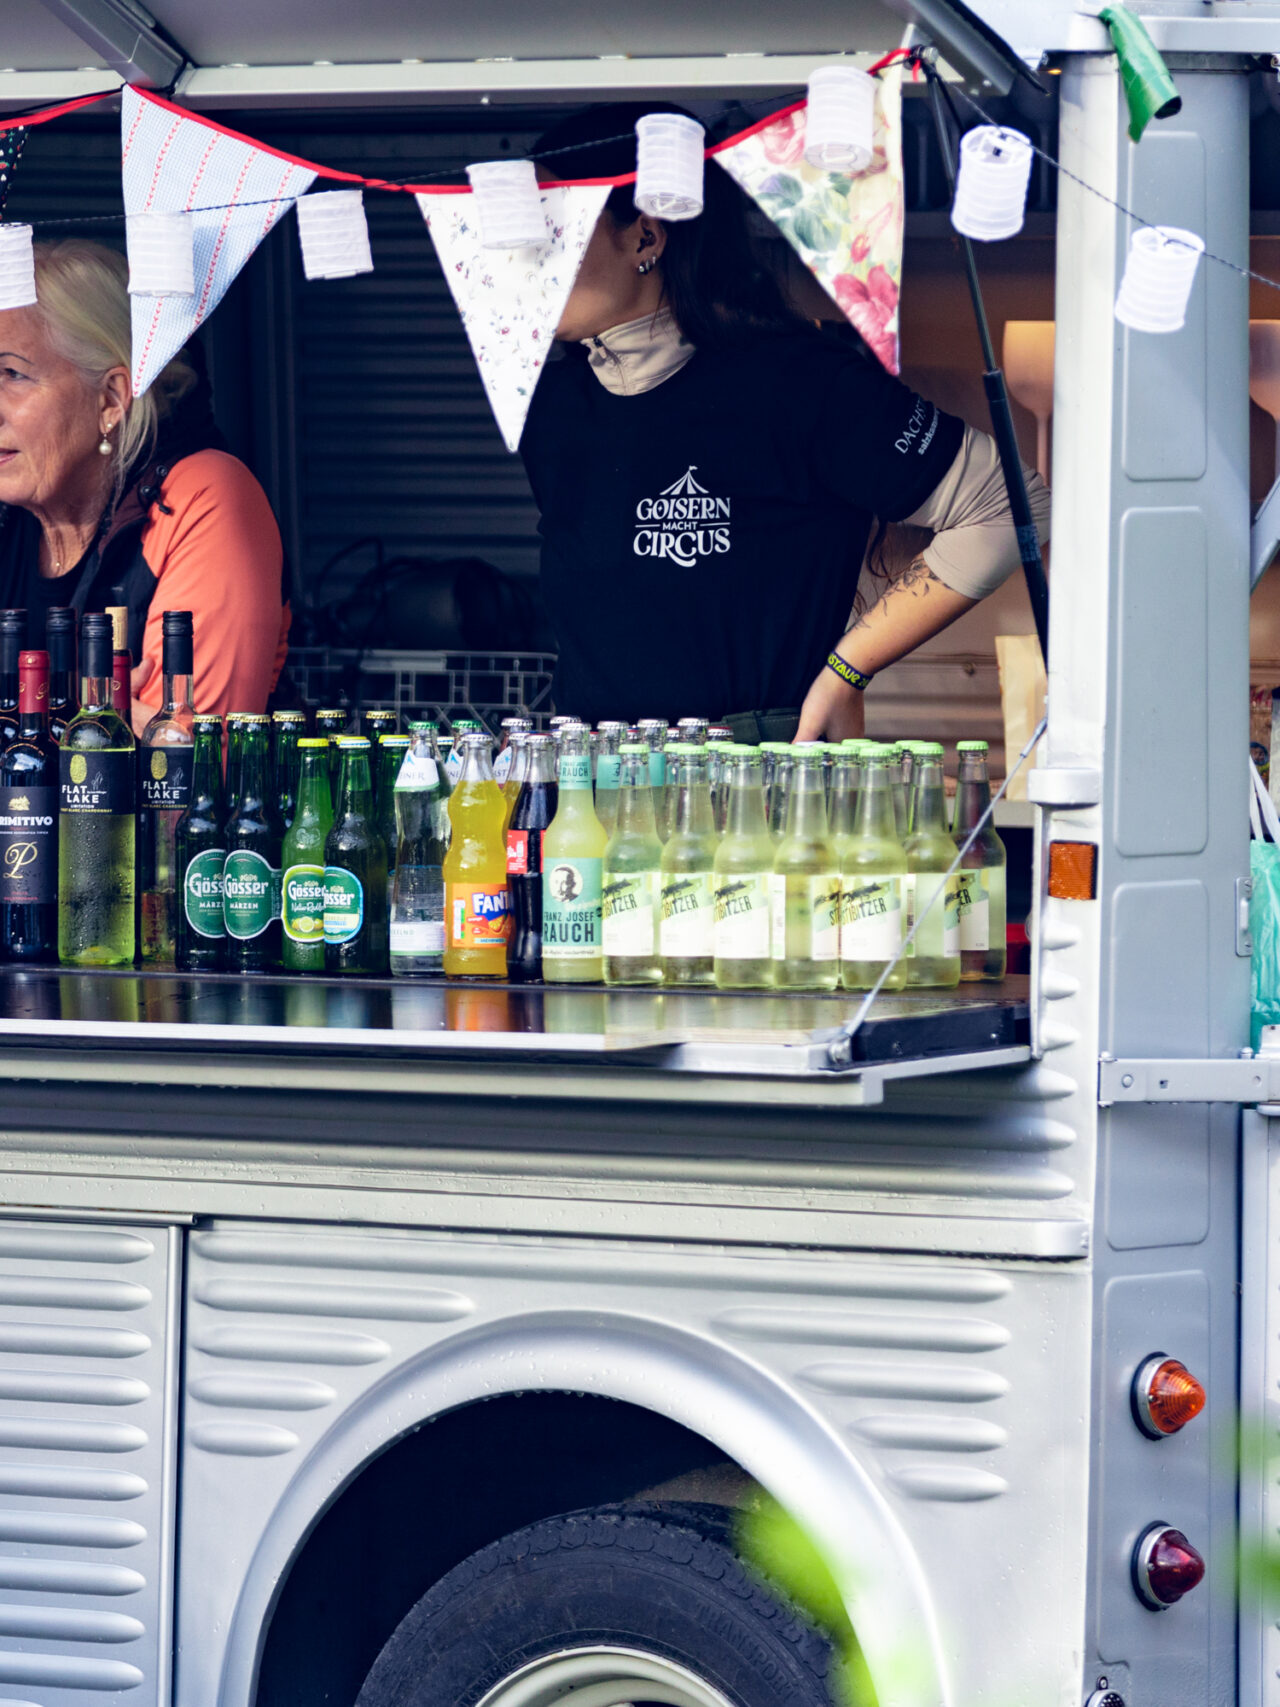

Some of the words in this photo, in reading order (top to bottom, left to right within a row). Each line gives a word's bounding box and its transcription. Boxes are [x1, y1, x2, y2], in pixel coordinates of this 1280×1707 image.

[636, 497, 731, 521] GOISERN
[662, 521, 698, 531] MACHT
[633, 528, 731, 567] CIRCUS
[562, 767, 589, 777] RAUCH
[61, 784, 87, 794] FLAT
[143, 781, 168, 790] FLAT
[66, 794, 99, 803] LAKE
[147, 790, 180, 799] LAKE
[224, 873, 269, 898] Gösser
[566, 911, 594, 921] JOSEF
[543, 922, 594, 942] RAUCH
